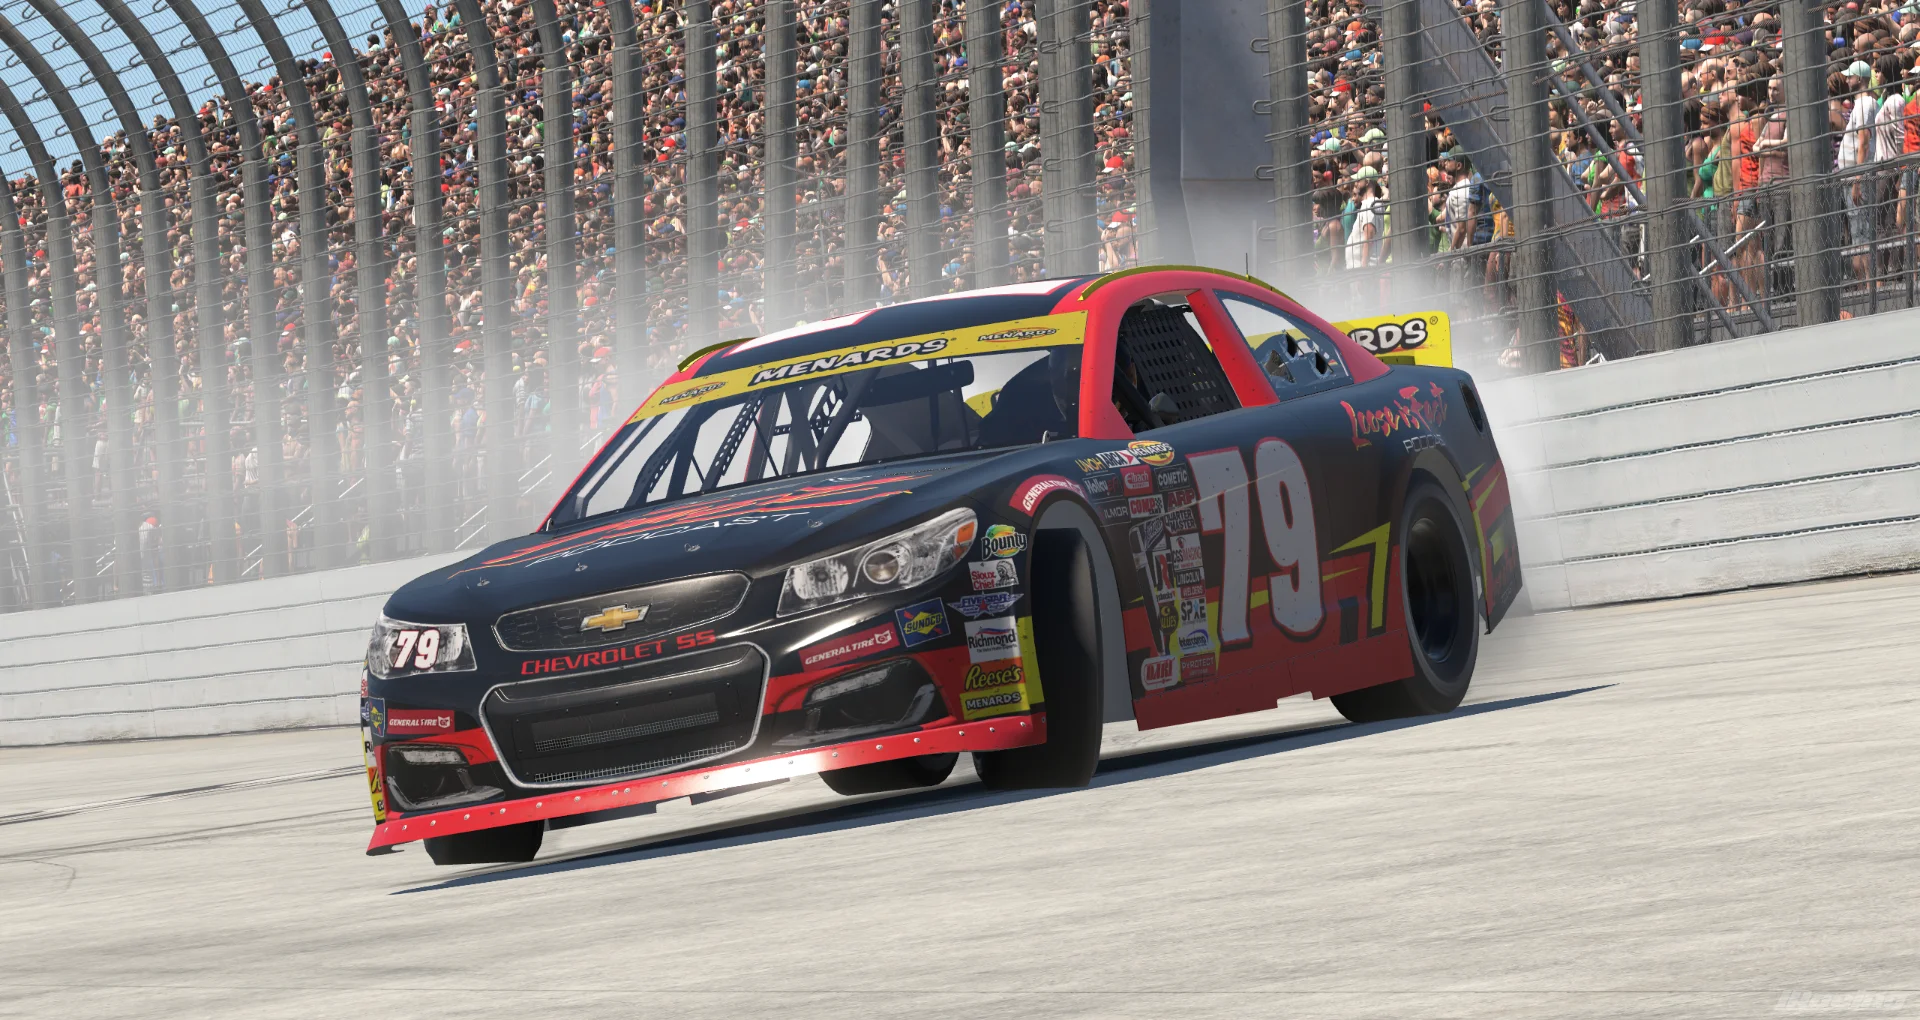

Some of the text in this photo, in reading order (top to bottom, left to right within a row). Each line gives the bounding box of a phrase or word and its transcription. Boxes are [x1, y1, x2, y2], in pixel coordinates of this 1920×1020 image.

[978, 328, 1057, 341] MENARDS
[748, 338, 948, 386] MENARDS
[1100, 450, 1127, 467] ARCA
[1129, 442, 1173, 459] MENARDS
[1157, 470, 1188, 486] COMETIC
[1168, 490, 1195, 508] ARP
[1170, 519, 1195, 532] MASTER
[982, 533, 1027, 560] Bounty
[1185, 436, 1326, 646] 79
[971, 570, 995, 581] Sioux
[1176, 571, 1200, 585] LINCOLN
[973, 579, 995, 590] Chief
[1182, 585, 1203, 597] WELDERS
[961, 593, 1008, 606] FIVE STAR
[905, 613, 943, 634] SUNOCO
[968, 629, 1016, 649] Richmond
[392, 628, 440, 670] 79
[521, 629, 716, 675] CHEVROLET SS
[805, 646, 851, 665] GENERAL
[852, 638, 875, 653] TIRE
[1181, 656, 1214, 671] PYROTECT
[966, 663, 1022, 691] Reese's
[966, 692, 1022, 710] MENARDS
[389, 718, 420, 727] GENERAL
[420, 718, 437, 727] TIRE
